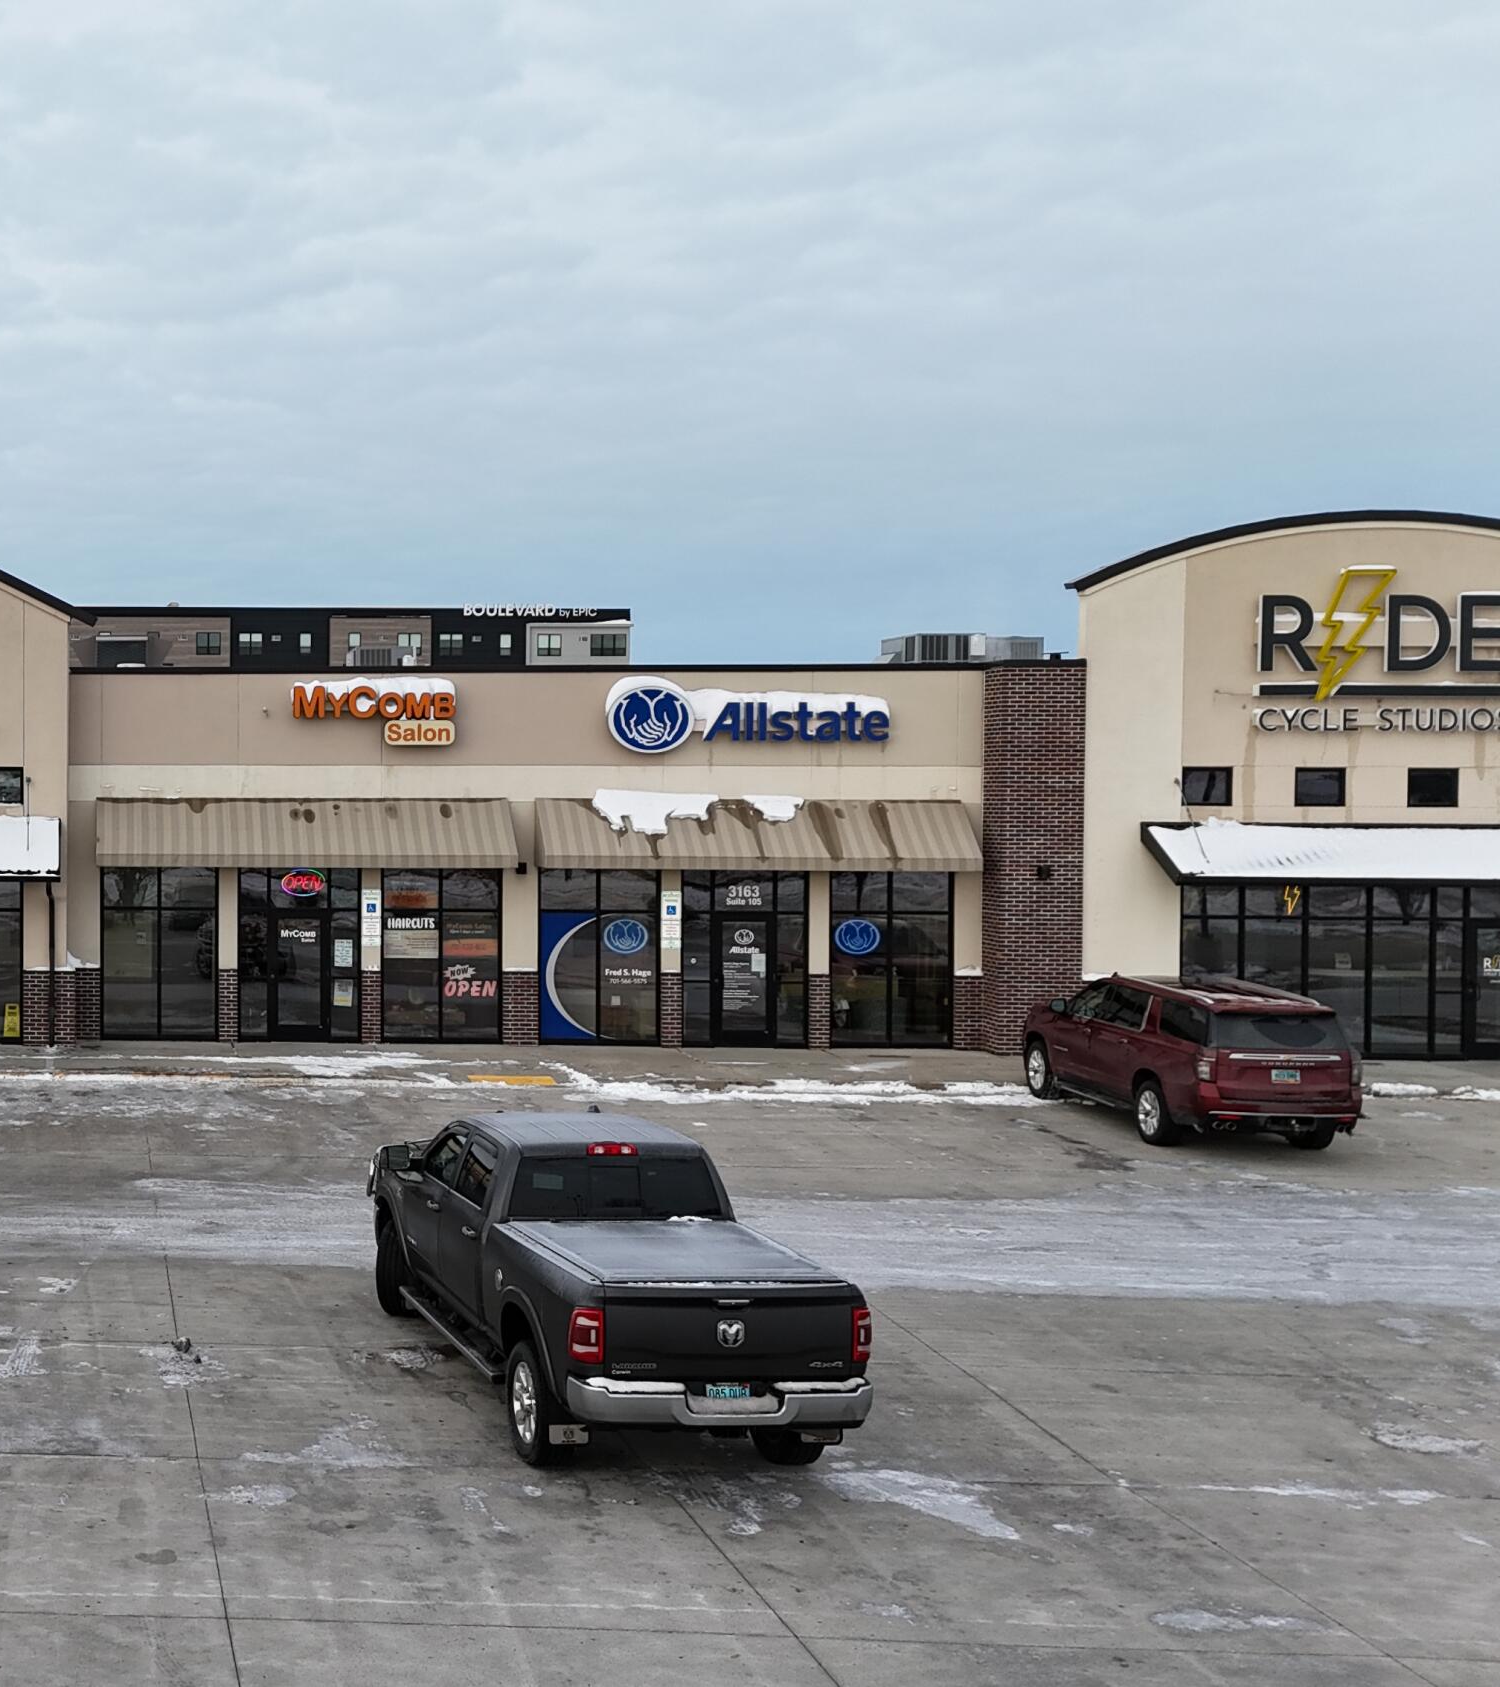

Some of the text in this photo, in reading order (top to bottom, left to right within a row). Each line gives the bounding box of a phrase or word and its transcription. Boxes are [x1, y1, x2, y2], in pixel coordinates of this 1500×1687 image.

[463, 603, 598, 619] BOULEVARD by EPIC
[703, 701, 890, 742] Allstate
[1258, 708, 1500, 732] CYCLE STUDIO
[387, 723, 451, 742] Salon
[284, 876, 322, 891] OPEN
[728, 885, 760, 898] 3163
[726, 897, 762, 906] Suite 105
[387, 917, 436, 929] HAIRCUTS
[729, 946, 760, 954] Allstate
[450, 967, 469, 977] NOW
[605, 968, 652, 978] Fred S. Hage
[444, 980, 497, 997] OPEN
